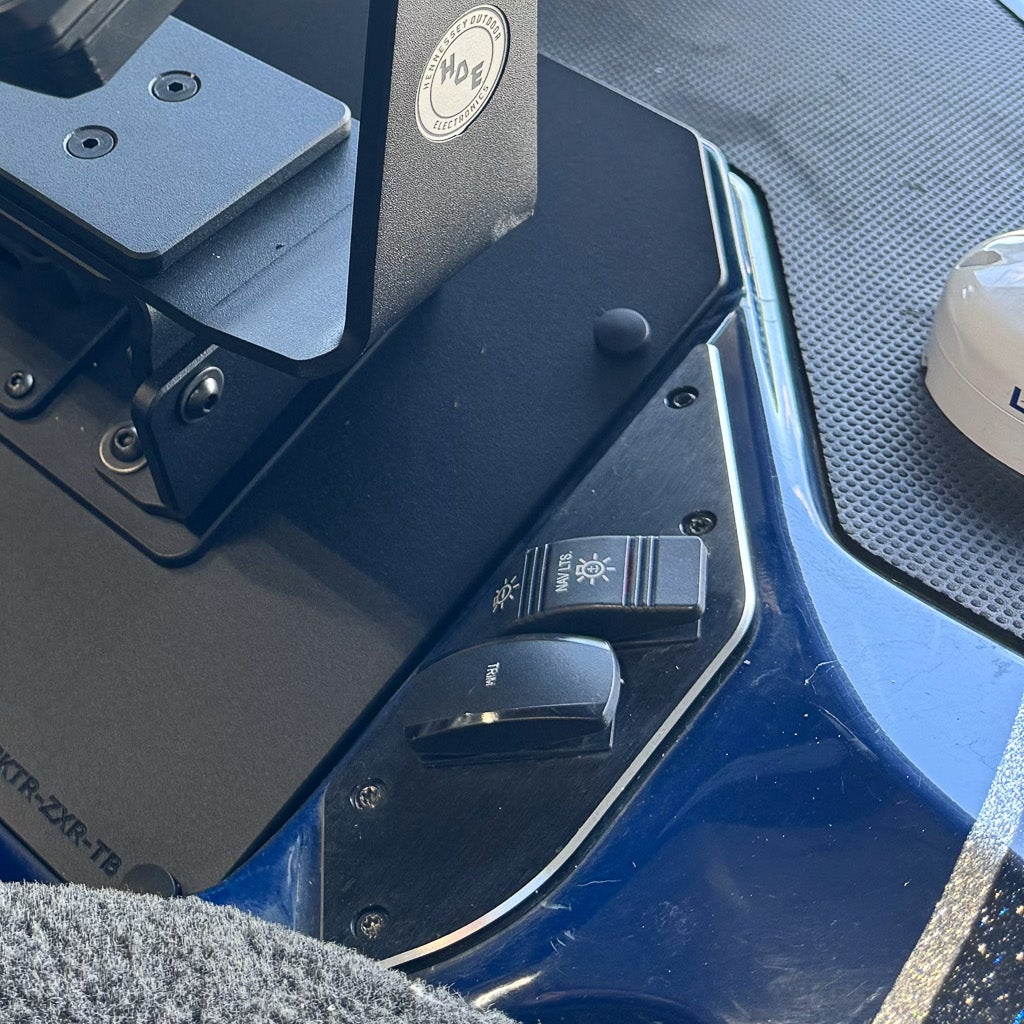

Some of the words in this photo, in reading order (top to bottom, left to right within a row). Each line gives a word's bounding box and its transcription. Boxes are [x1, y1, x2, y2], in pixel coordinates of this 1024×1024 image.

[423, 20, 468, 90] HENNESSEY
[470, 14, 502, 42] OUTDOOR
[433, 85, 489, 131] ELECTRONICS
[555, 573, 569, 592] NAV
[485, 662, 500, 687] TRIM
